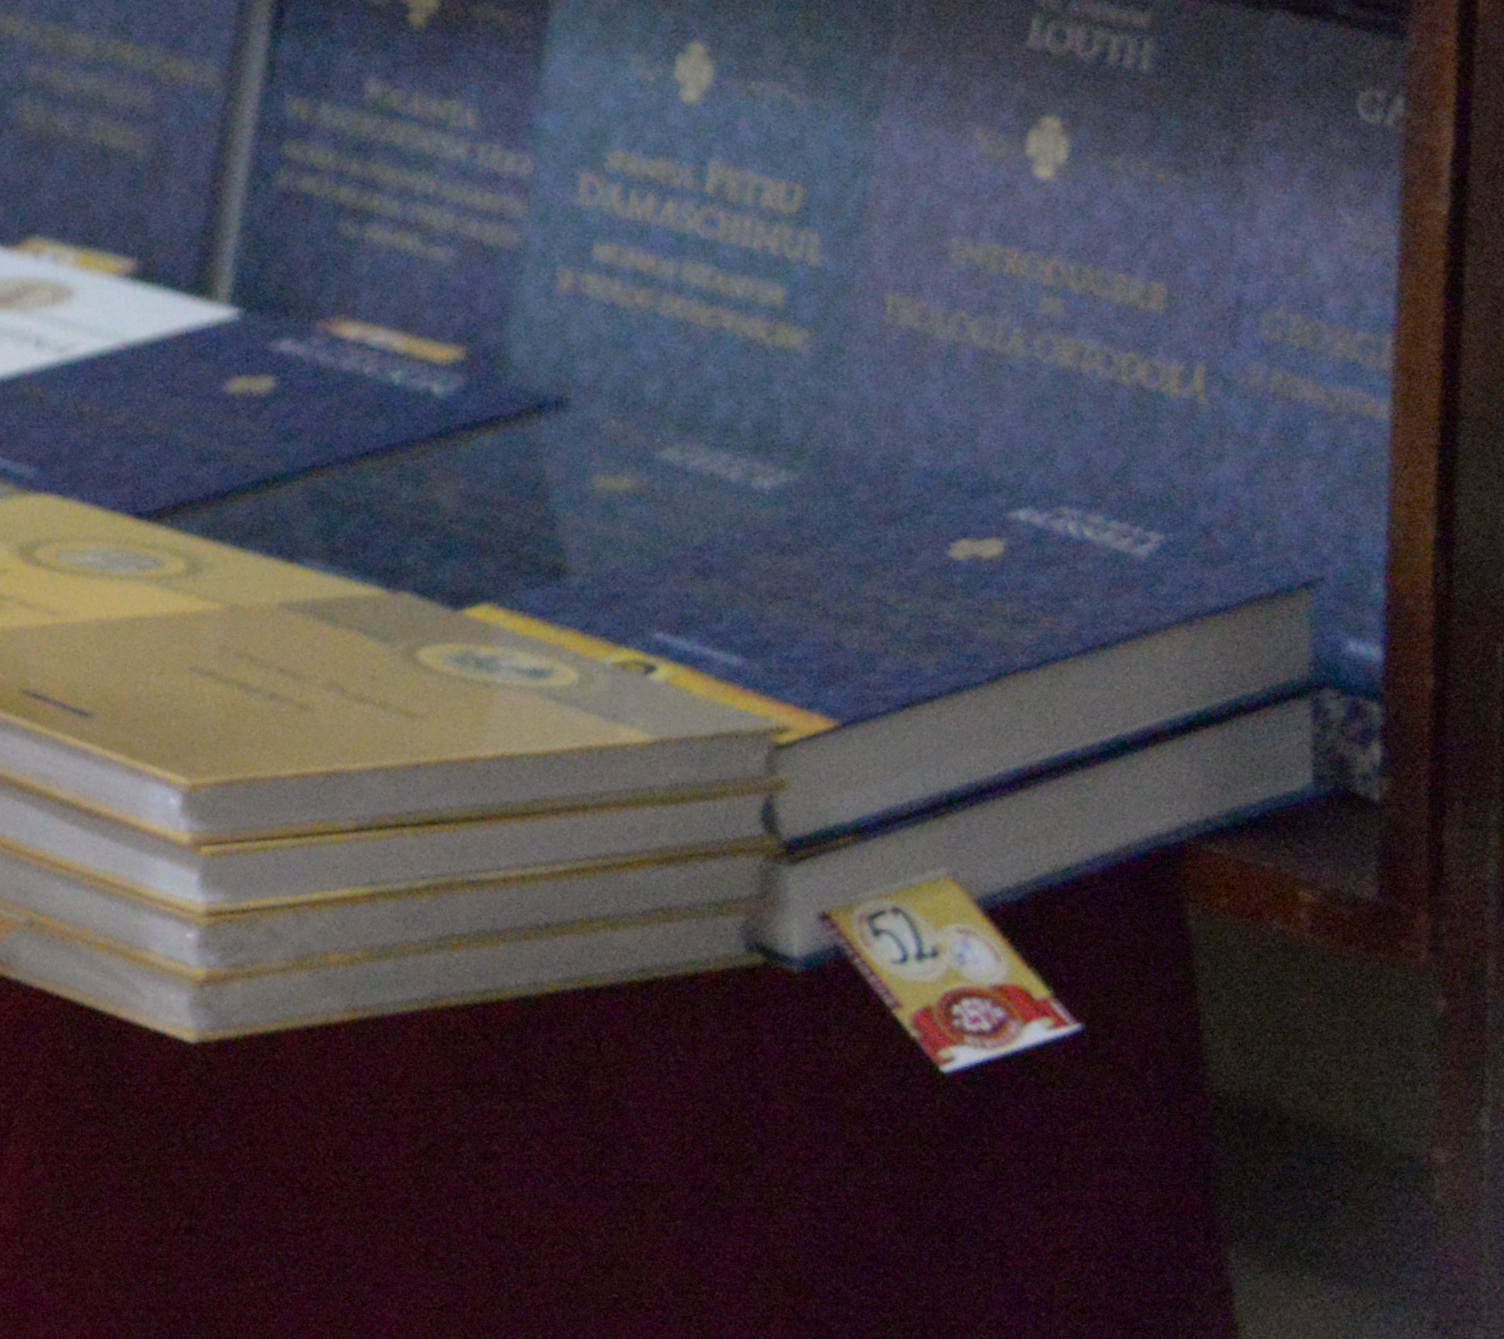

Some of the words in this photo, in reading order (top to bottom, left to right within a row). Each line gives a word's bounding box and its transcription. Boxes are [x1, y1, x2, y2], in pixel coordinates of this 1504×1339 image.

[1025, 13, 1155, 74] LOUTH
[702, 157, 805, 216] PETRU
[576, 169, 824, 268] DAMASCHINUL
